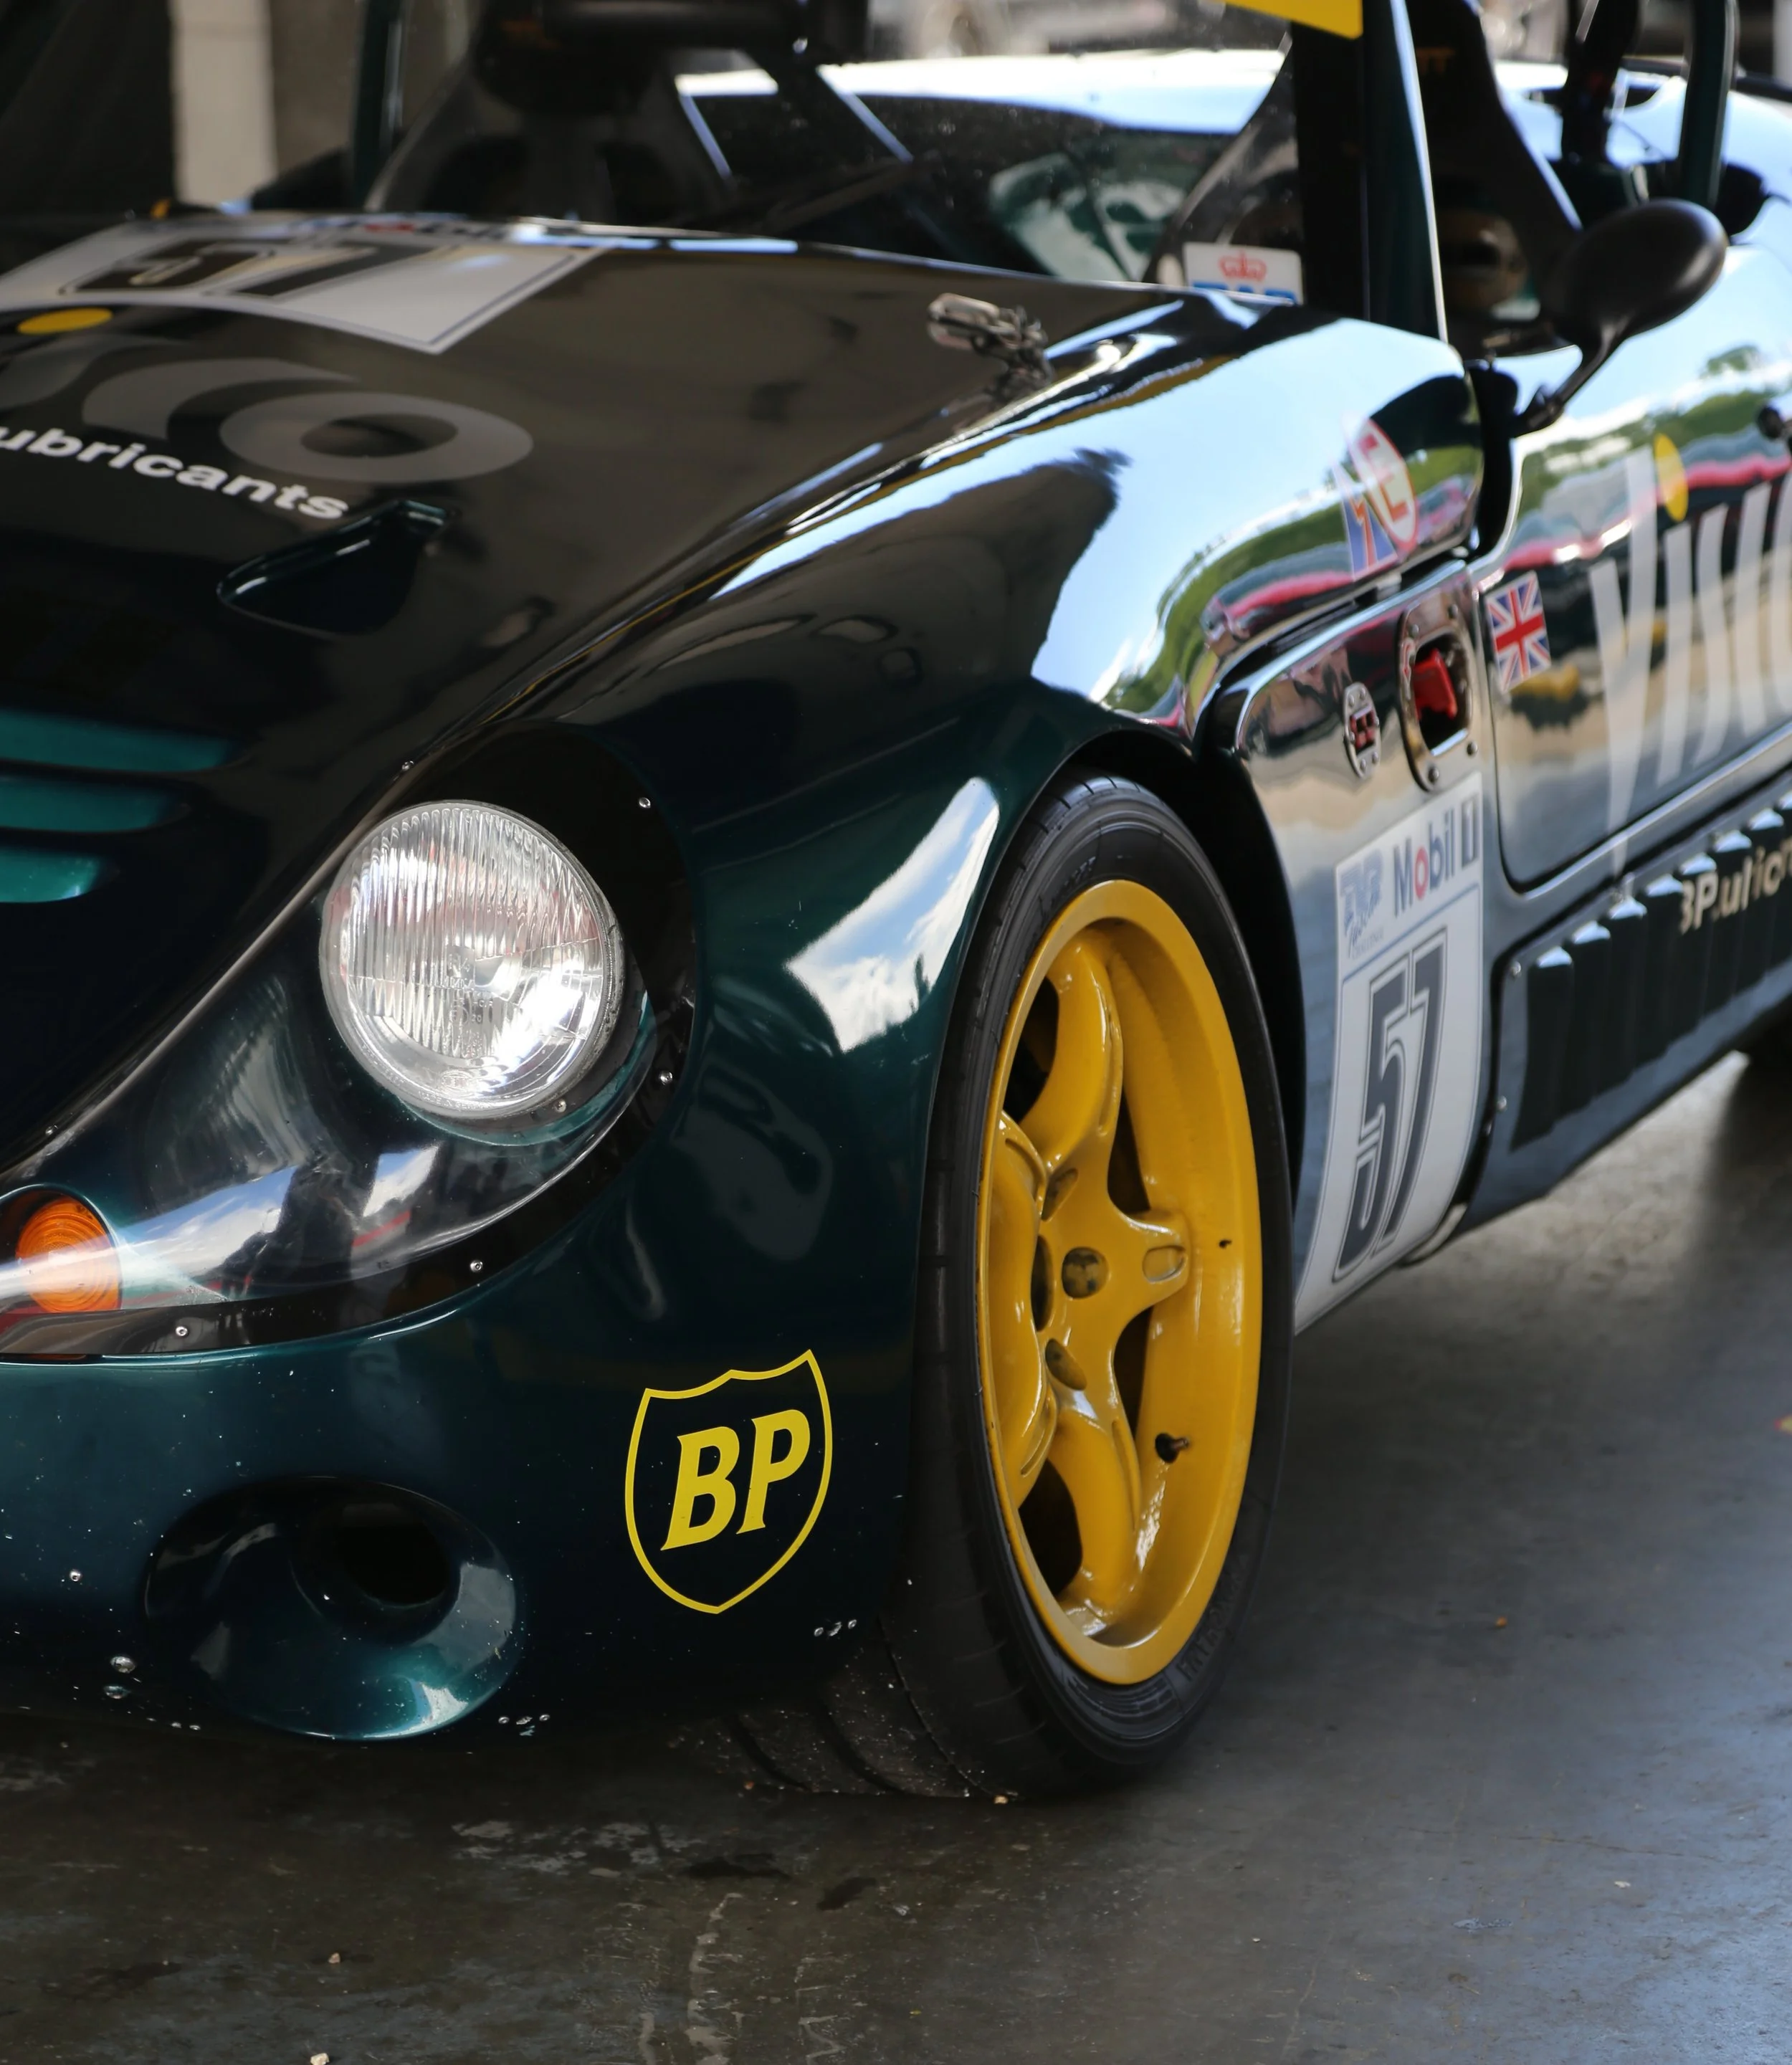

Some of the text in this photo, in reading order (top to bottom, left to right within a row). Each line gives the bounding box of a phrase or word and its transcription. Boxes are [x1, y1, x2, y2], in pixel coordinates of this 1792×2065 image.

[1393, 804, 1456, 919] Mobil
[1333, 925, 1448, 1282] 57
[660, 1408, 811, 1551] BP
